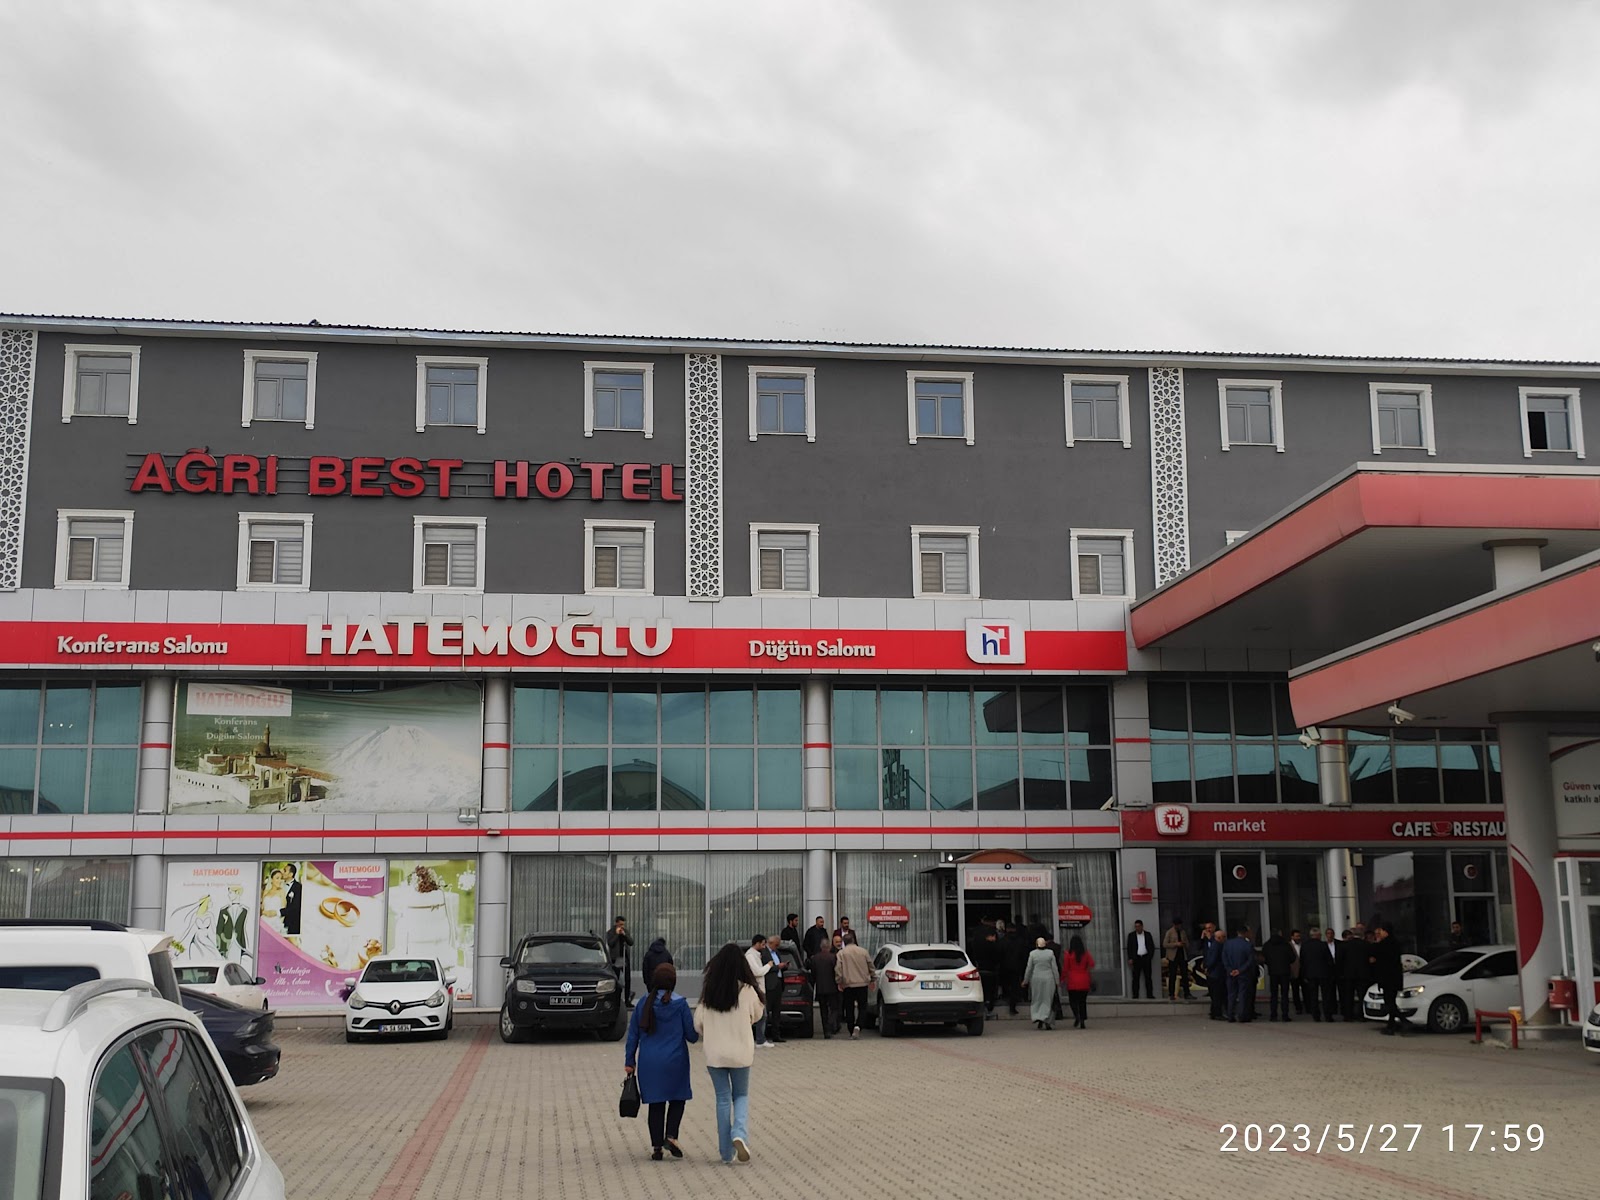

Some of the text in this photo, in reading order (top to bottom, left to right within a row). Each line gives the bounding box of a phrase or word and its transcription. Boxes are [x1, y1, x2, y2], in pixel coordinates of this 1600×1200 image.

[130, 446, 684, 501] AĞRI BEST HOTEL
[305, 606, 674, 657] HATEMOĞLU
[57, 633, 228, 654] Konferans Salonu
[749, 638, 876, 661] Düğün Salonu
[214, 717, 258, 726] Konferans
[238, 733, 266, 741] Salonu
[1563, 781, 1591, 791] Güven
[1166, 814, 1182, 826] TP
[1213, 819, 1266, 832] market
[1392, 821, 1506, 837] CAFE RESTAU
